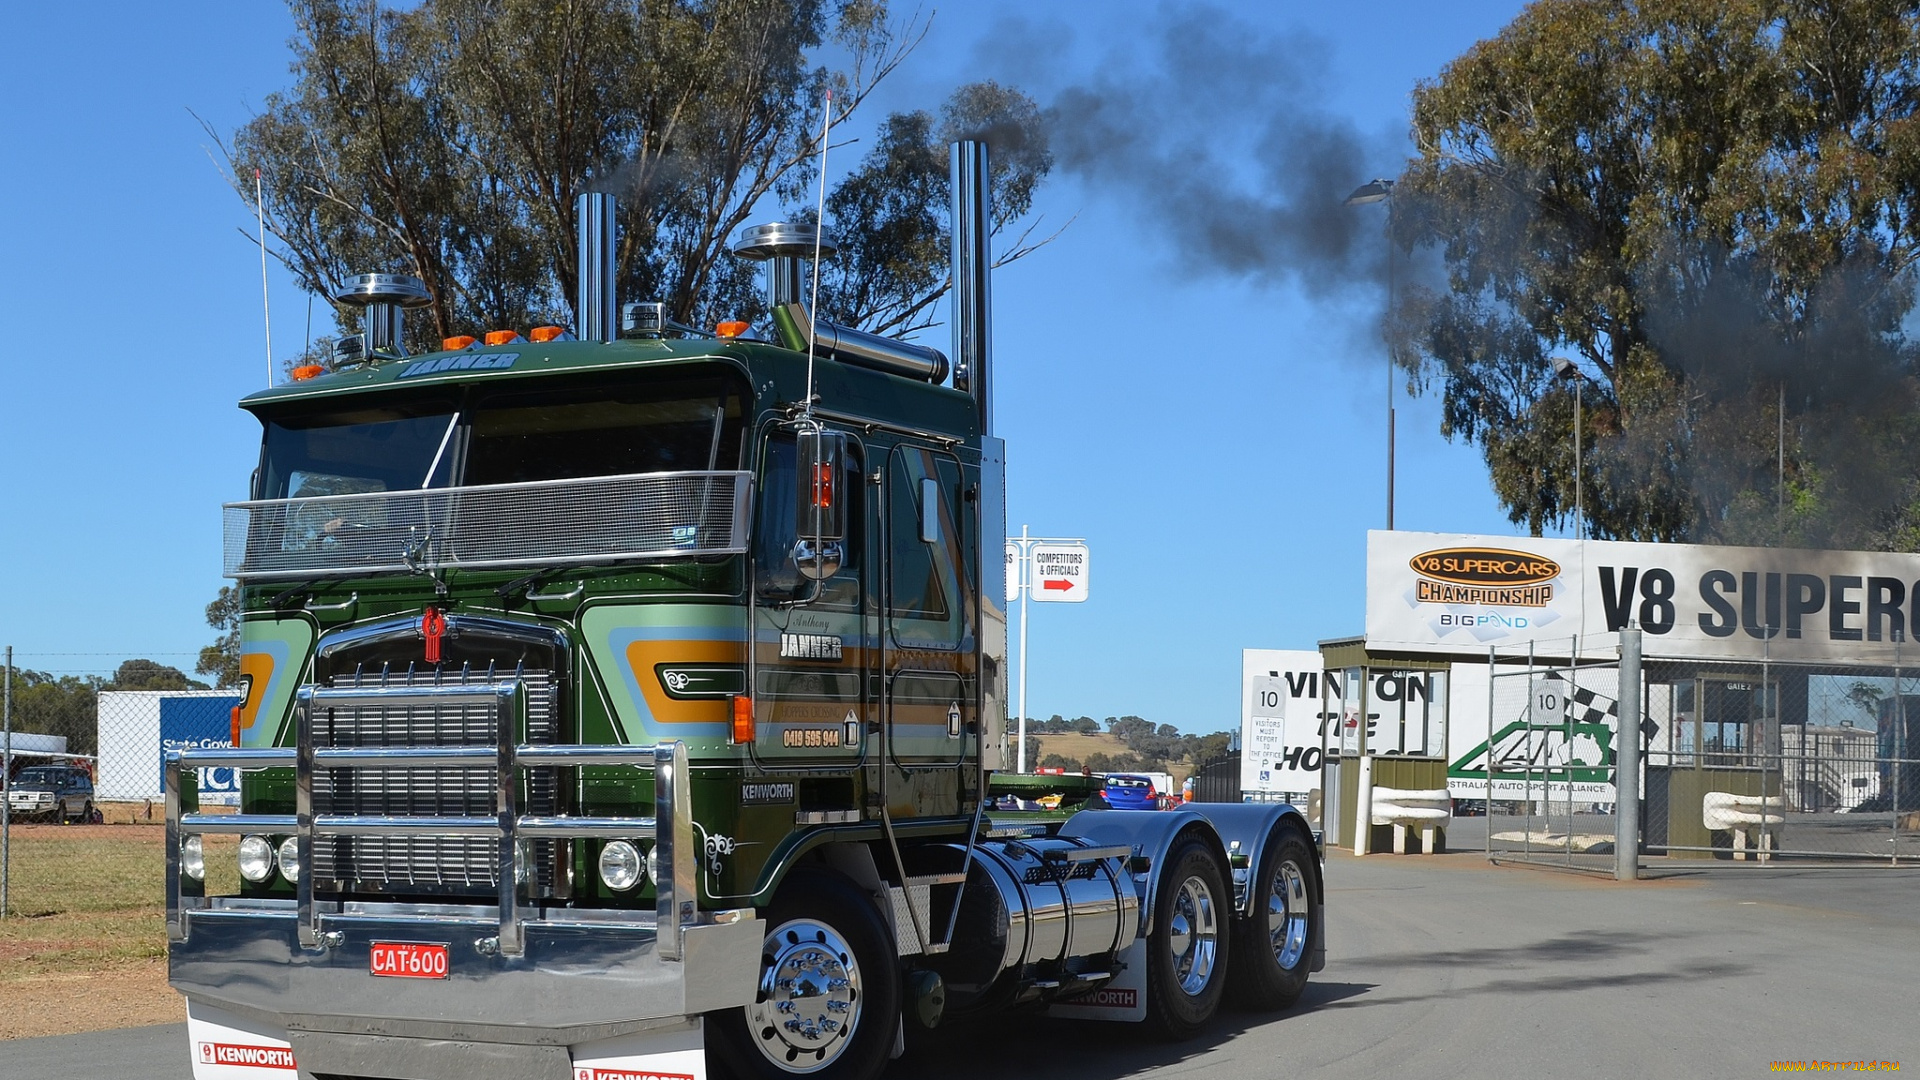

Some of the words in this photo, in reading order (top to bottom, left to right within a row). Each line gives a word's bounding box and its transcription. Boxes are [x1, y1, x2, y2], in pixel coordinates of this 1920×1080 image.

[400, 353, 520, 377] JANNER
[1036, 553, 1083, 564] COMPETITORS
[1415, 557, 1441, 571] V8
[1443, 558, 1556, 576] SUPERCARS
[1039, 565, 1045, 575] &
[1046, 565, 1079, 576] OFFICIALS
[1417, 580, 1552, 606] CHAMPIONSHIP
[1598, 566, 1675, 636] V8
[1697, 569, 1920, 643] SUPER
[793, 614, 830, 633] Anthony
[780, 633, 842, 659] JANNER
[1727, 682, 1746, 691] GATE
[1261, 691, 1278, 708] 10
[1538, 694, 1556, 711] 10
[1255, 720, 1281, 728] VISITORS
[783, 730, 804, 747] 0419
[804, 730, 821, 747] 595
[822, 730, 839, 747] 944
[1262, 751, 1282, 759] OFFICE
[742, 784, 793, 799] KENWORTH
[1446, 781, 1496, 790] STRALIAN
[217, 1047, 294, 1066] KENWORTH
